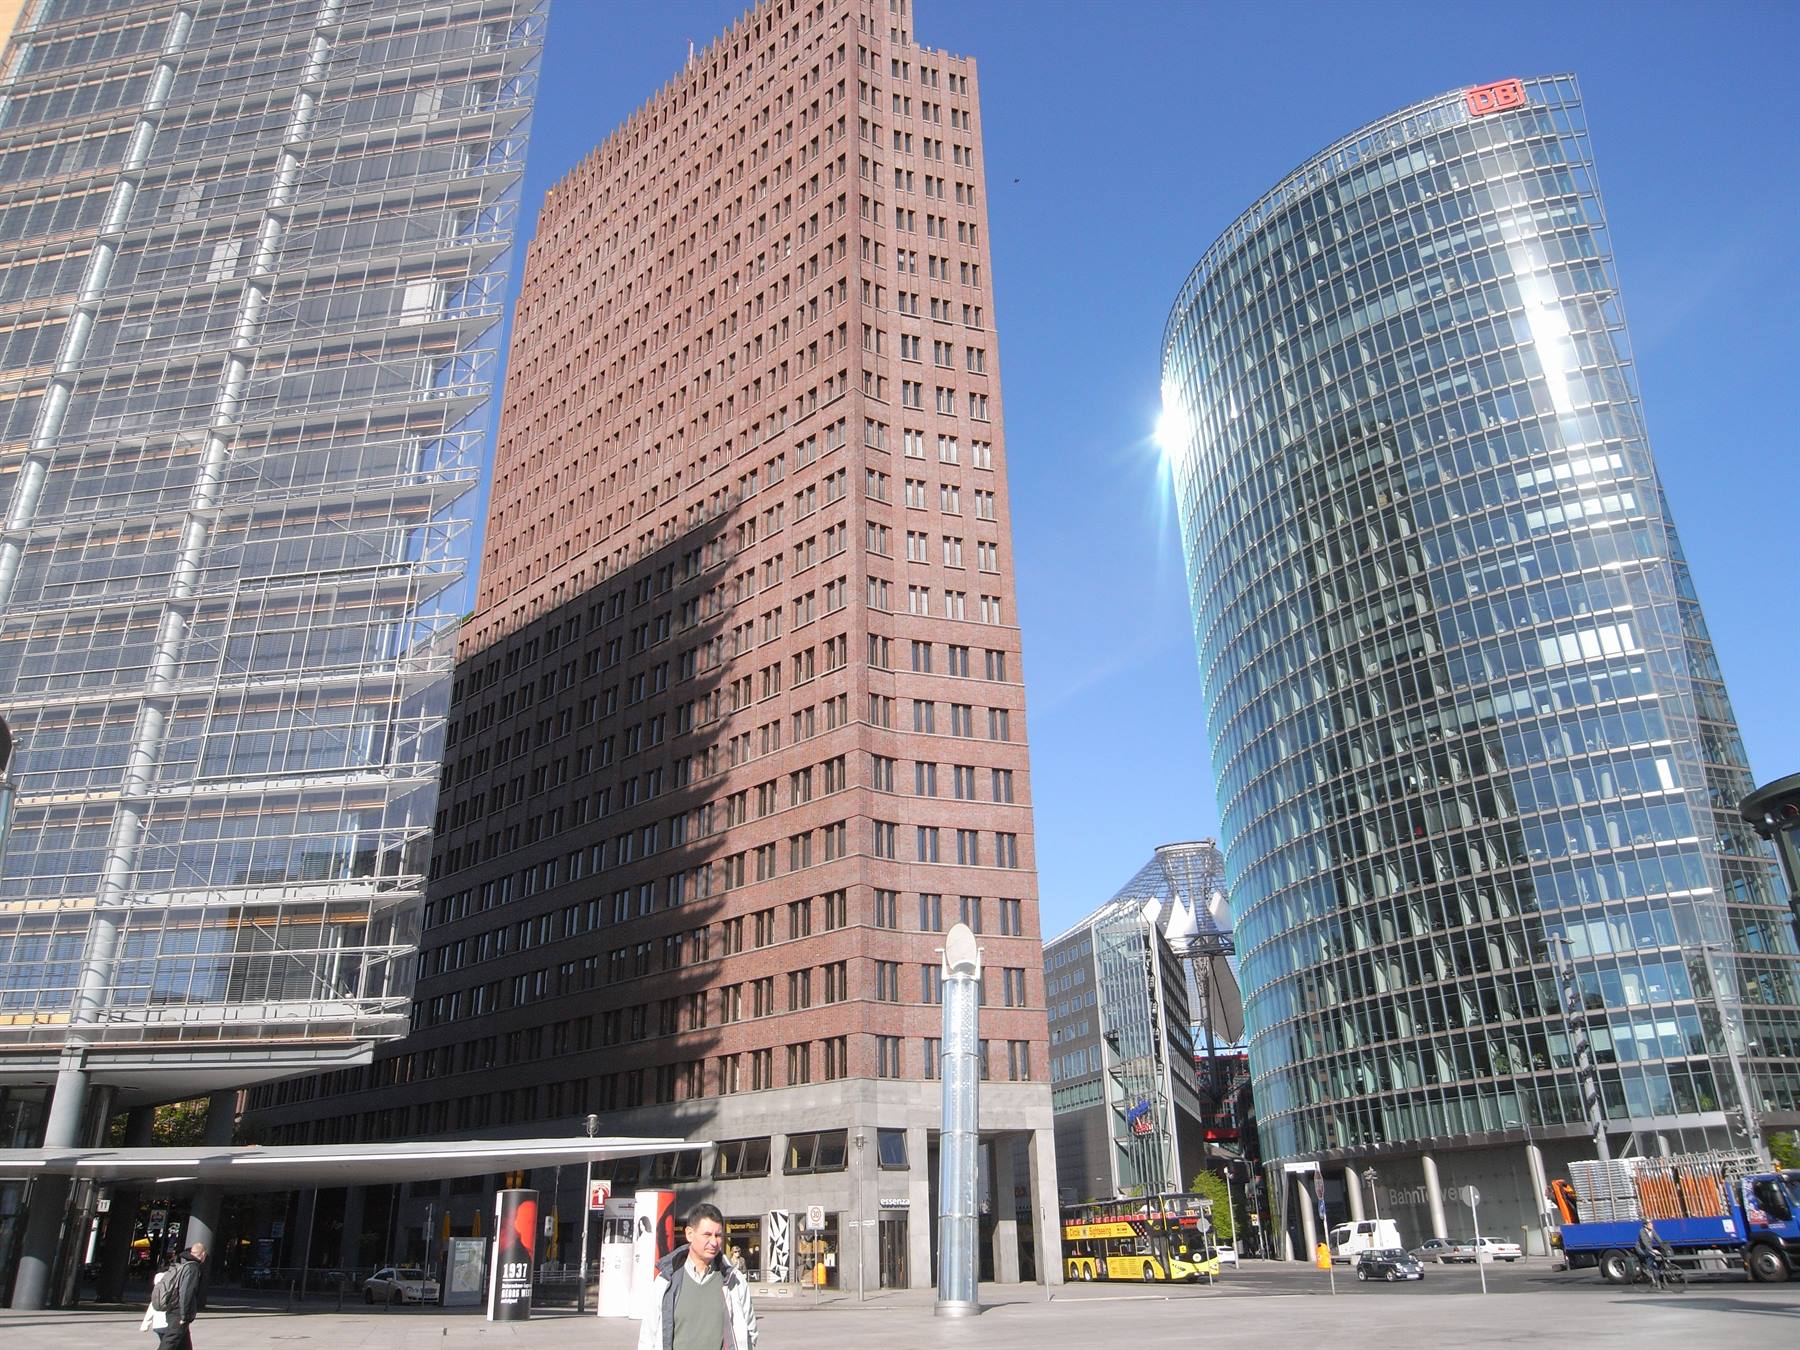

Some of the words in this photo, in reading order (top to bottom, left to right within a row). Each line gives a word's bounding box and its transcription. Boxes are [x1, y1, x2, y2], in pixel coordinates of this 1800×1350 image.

[1473, 85, 1518, 111] DB
[1389, 1185, 1464, 1205] BahnTwer
[503, 1263, 527, 1278] 1937
